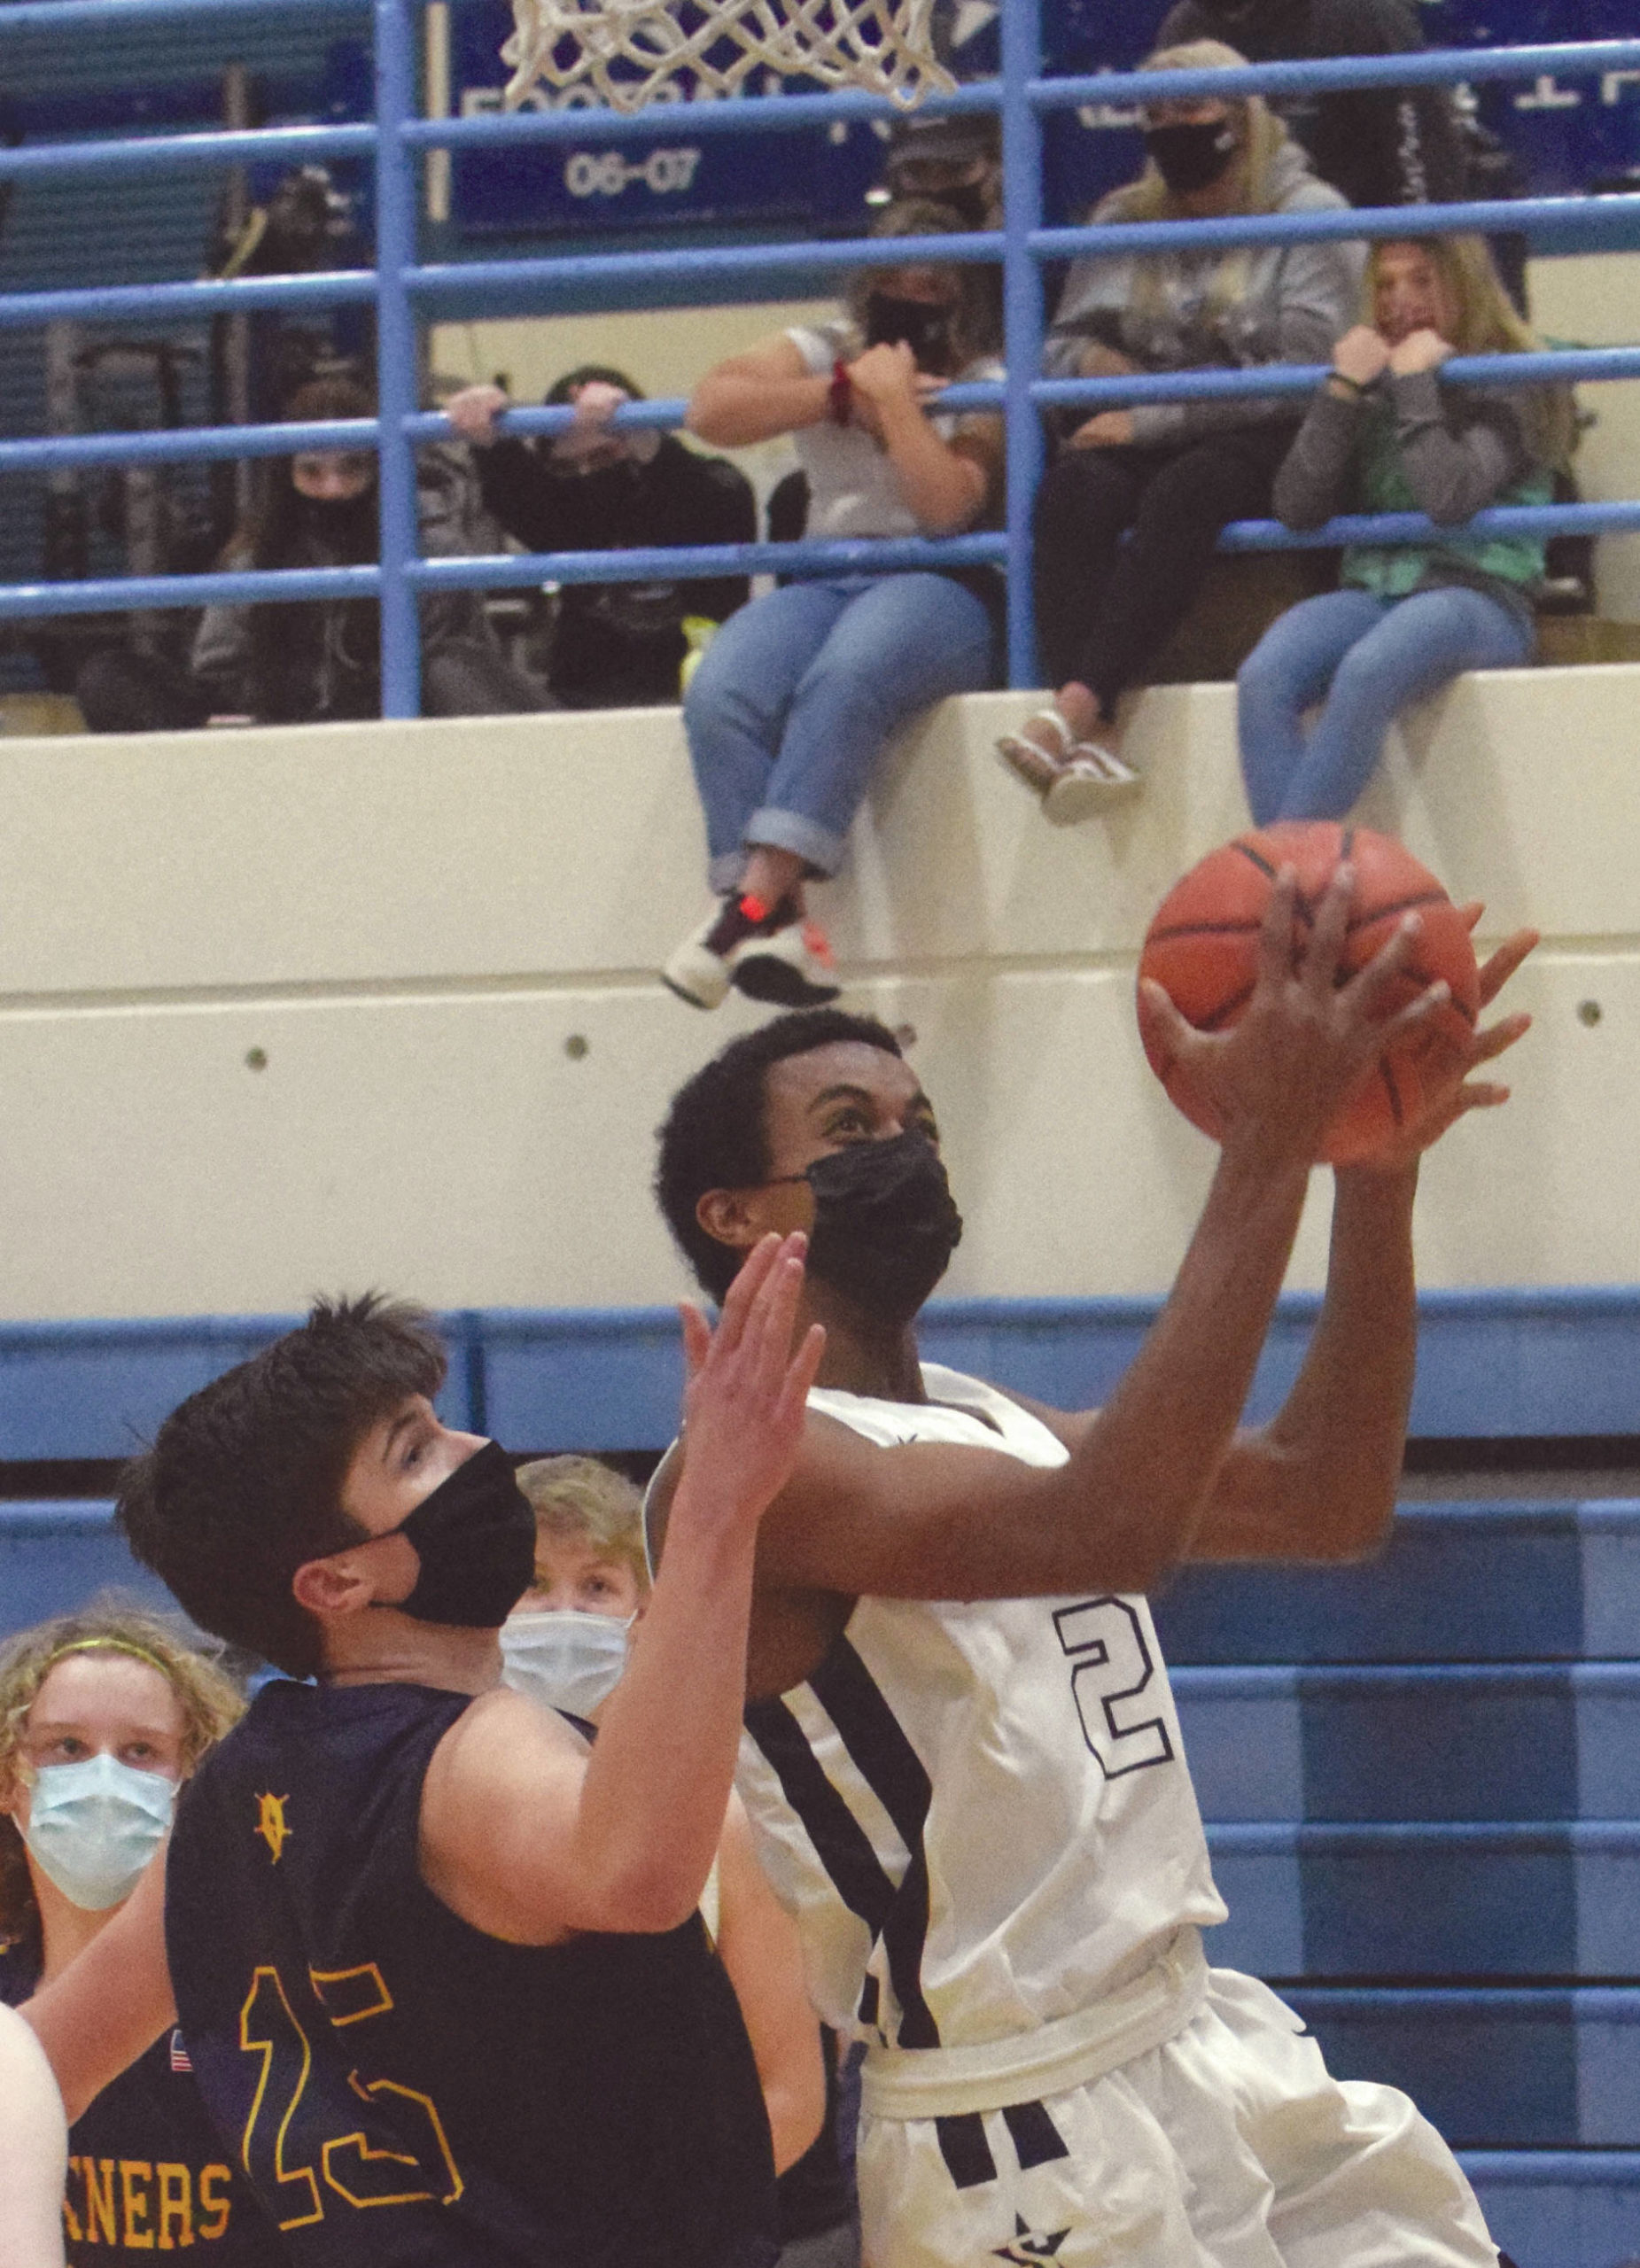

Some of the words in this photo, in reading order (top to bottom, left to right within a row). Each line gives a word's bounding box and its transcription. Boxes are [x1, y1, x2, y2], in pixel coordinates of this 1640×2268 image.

[564, 149, 701, 197] 06-07
[1052, 1596, 1175, 1782] 2
[239, 1961, 465, 2231] 15
